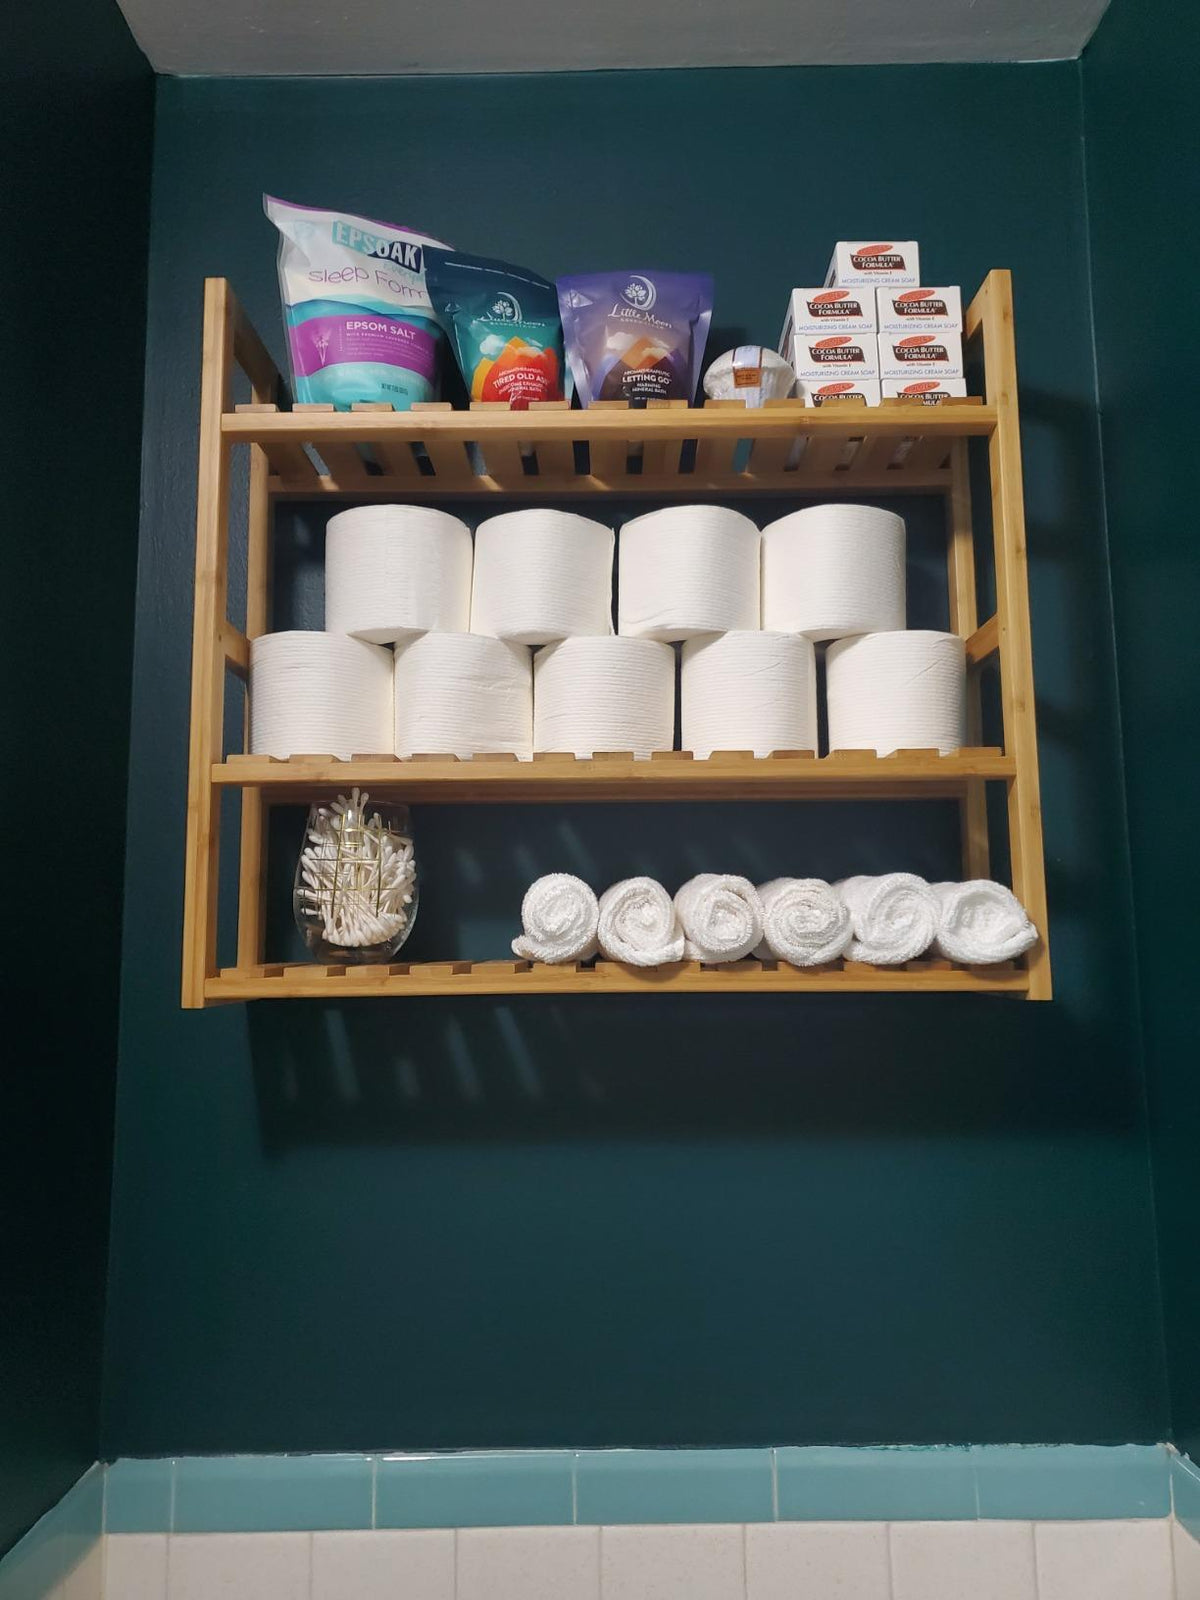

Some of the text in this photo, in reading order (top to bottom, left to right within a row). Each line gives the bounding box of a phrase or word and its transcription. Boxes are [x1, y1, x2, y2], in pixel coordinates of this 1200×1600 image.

[335, 221, 419, 270] EPSOAK
[308, 266, 370, 284] sleep
[608, 303, 640, 318] Little
[643, 312, 672, 328] Moon
[346, 321, 416, 340] EPSOM SALT
[492, 374, 516, 388] TIRED
[622, 374, 670, 385] LETTING GO
